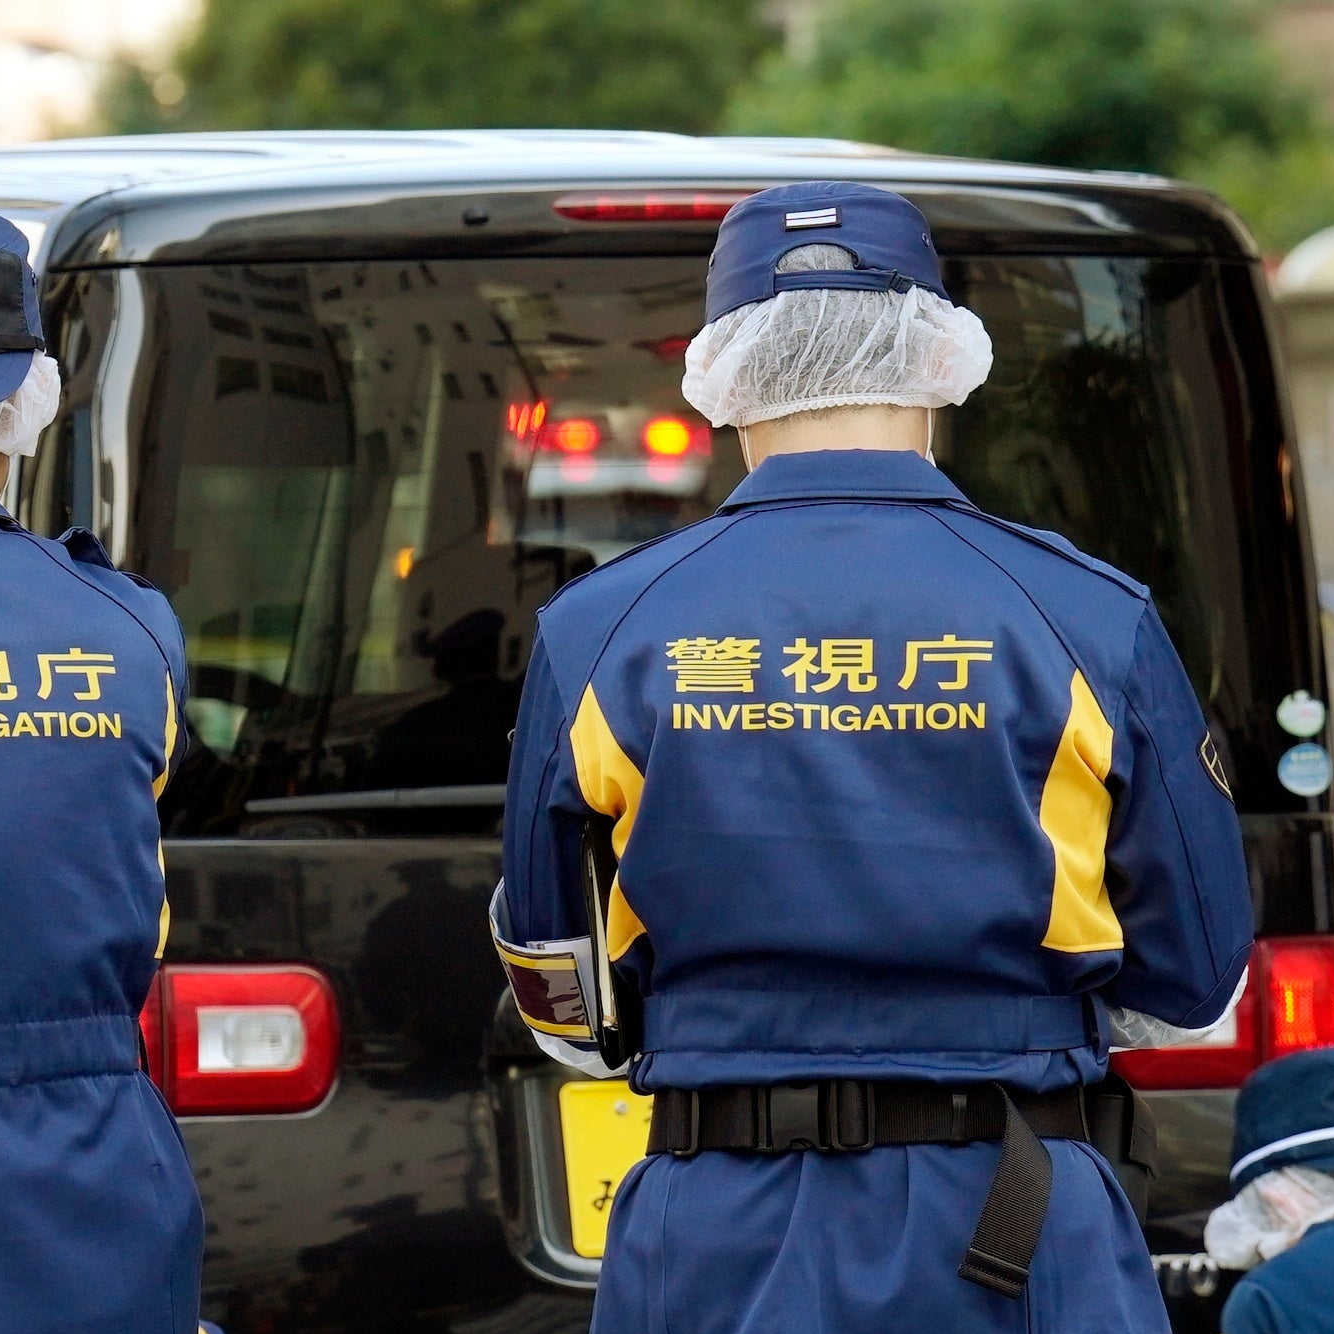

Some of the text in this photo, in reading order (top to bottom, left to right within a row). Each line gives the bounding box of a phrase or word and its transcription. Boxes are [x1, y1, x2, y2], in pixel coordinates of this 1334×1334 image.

[664, 633, 994, 694] 警視庁
[672, 702, 986, 732] INVESTIGATION
